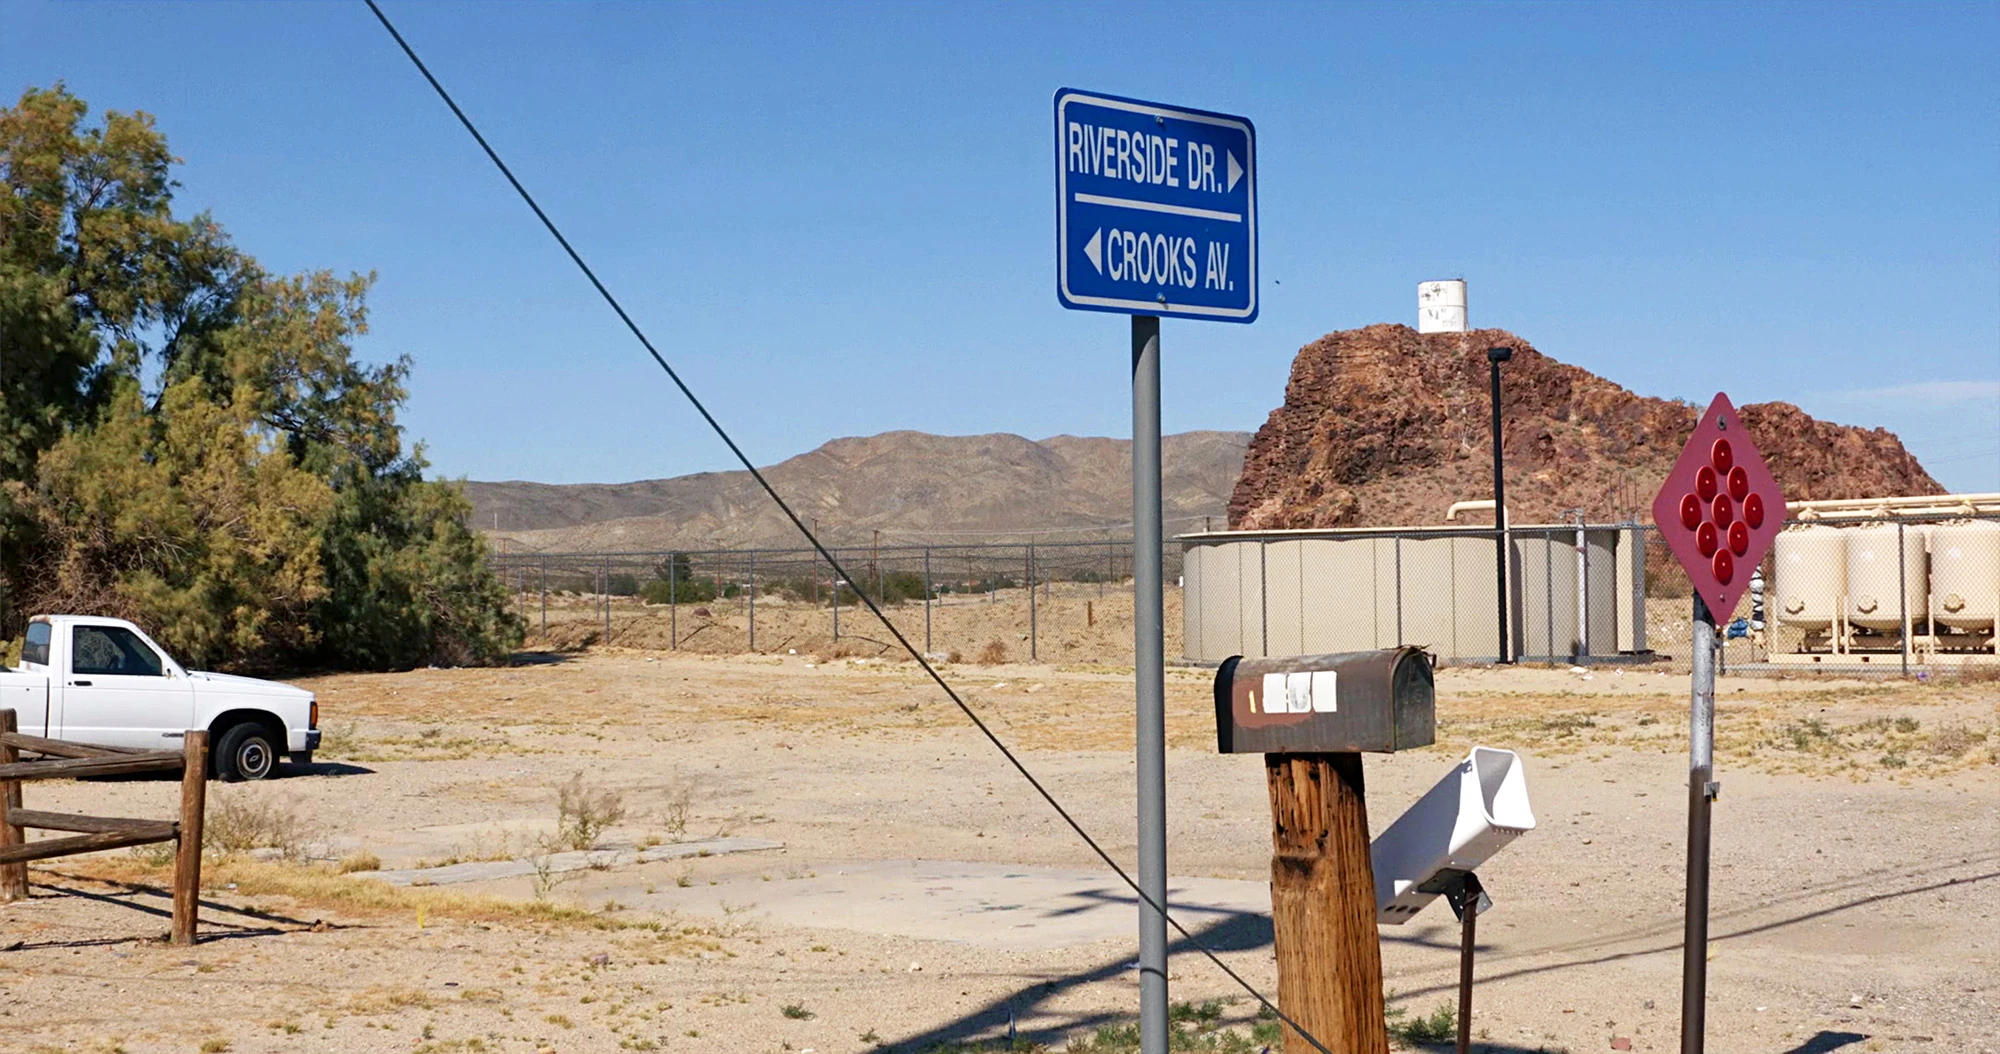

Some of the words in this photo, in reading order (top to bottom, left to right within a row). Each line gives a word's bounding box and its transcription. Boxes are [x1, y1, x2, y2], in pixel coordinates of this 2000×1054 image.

[1069, 121, 1179, 187] RIVERSIDE
[1188, 141, 1222, 193] DR.
[1107, 228, 1197, 288] CROOKS
[1205, 241, 1234, 291] AV.
